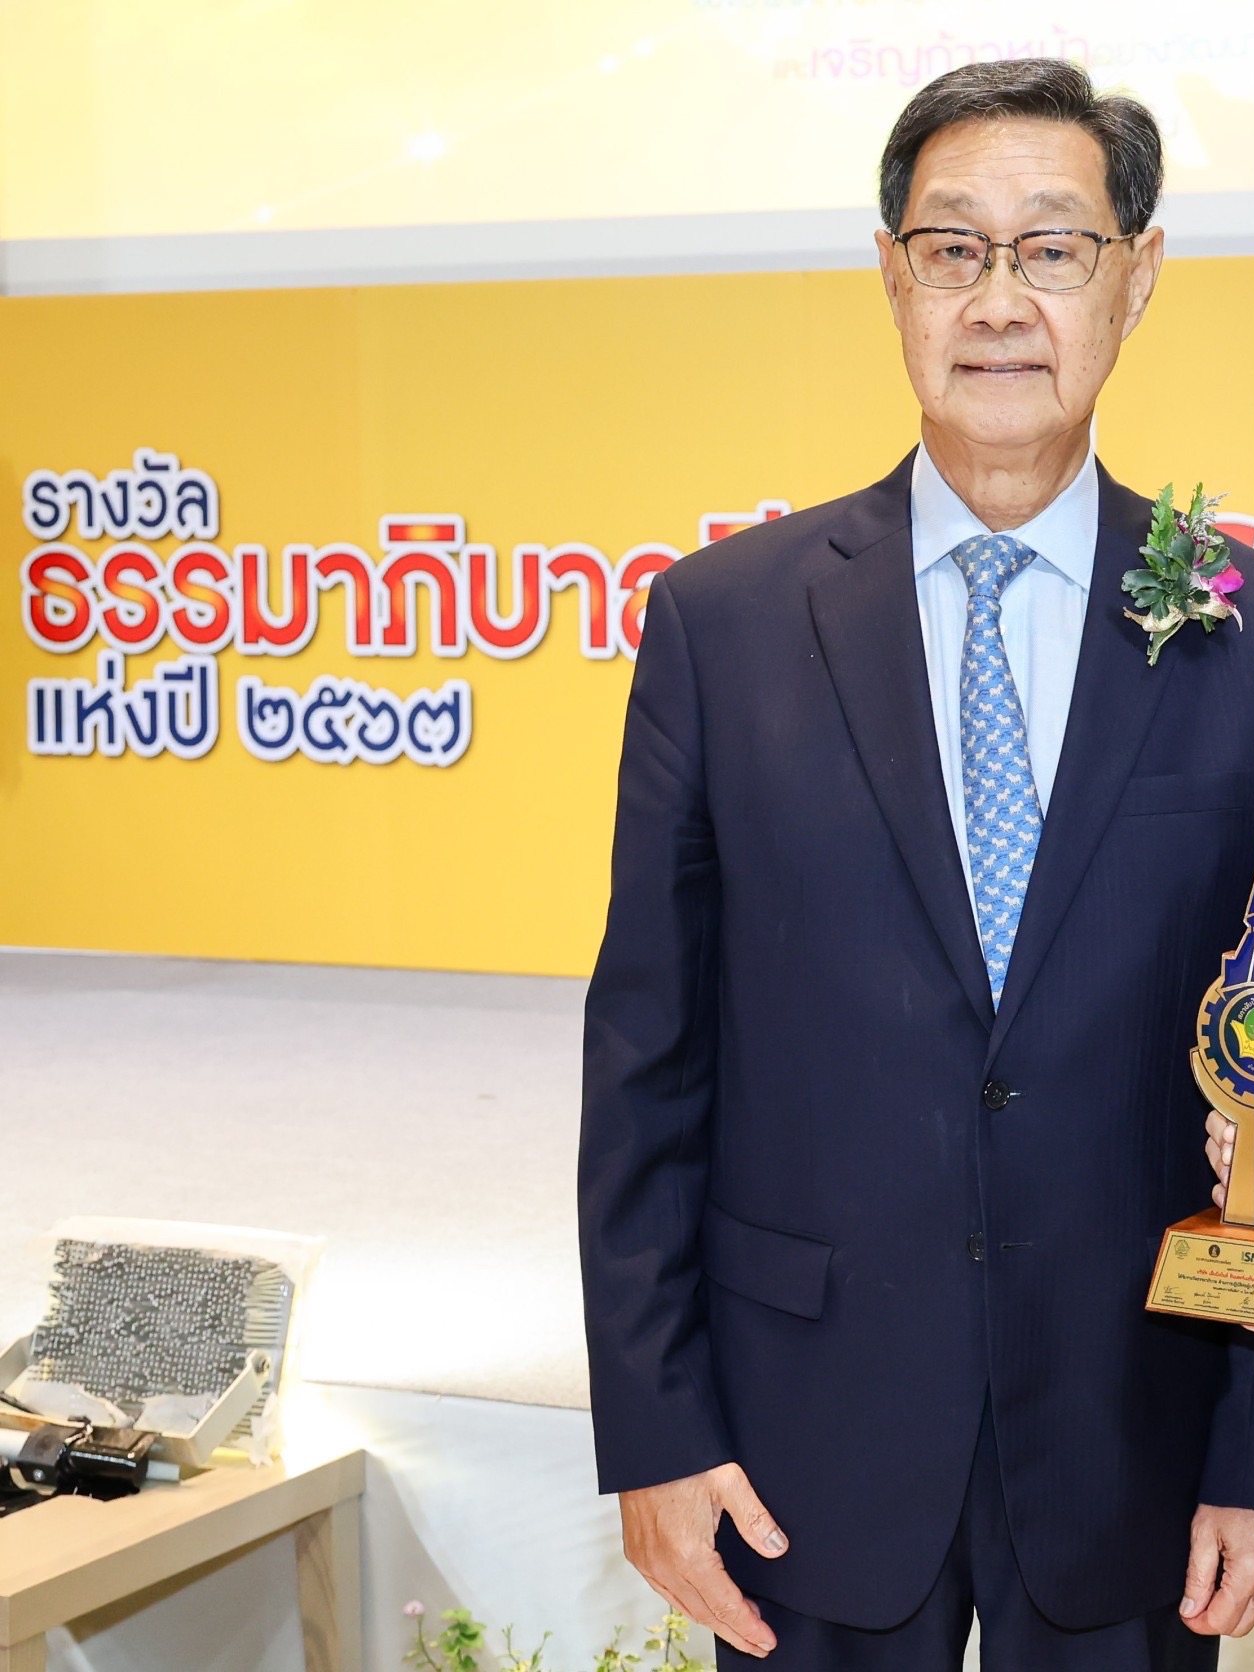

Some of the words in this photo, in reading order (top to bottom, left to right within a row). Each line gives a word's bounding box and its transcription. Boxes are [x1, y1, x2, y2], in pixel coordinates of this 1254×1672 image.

[31, 456, 210, 528] รางวัล
[36, 659, 209, 746] แห่งปี
[245, 685, 462, 755] ๒๕๖๗
